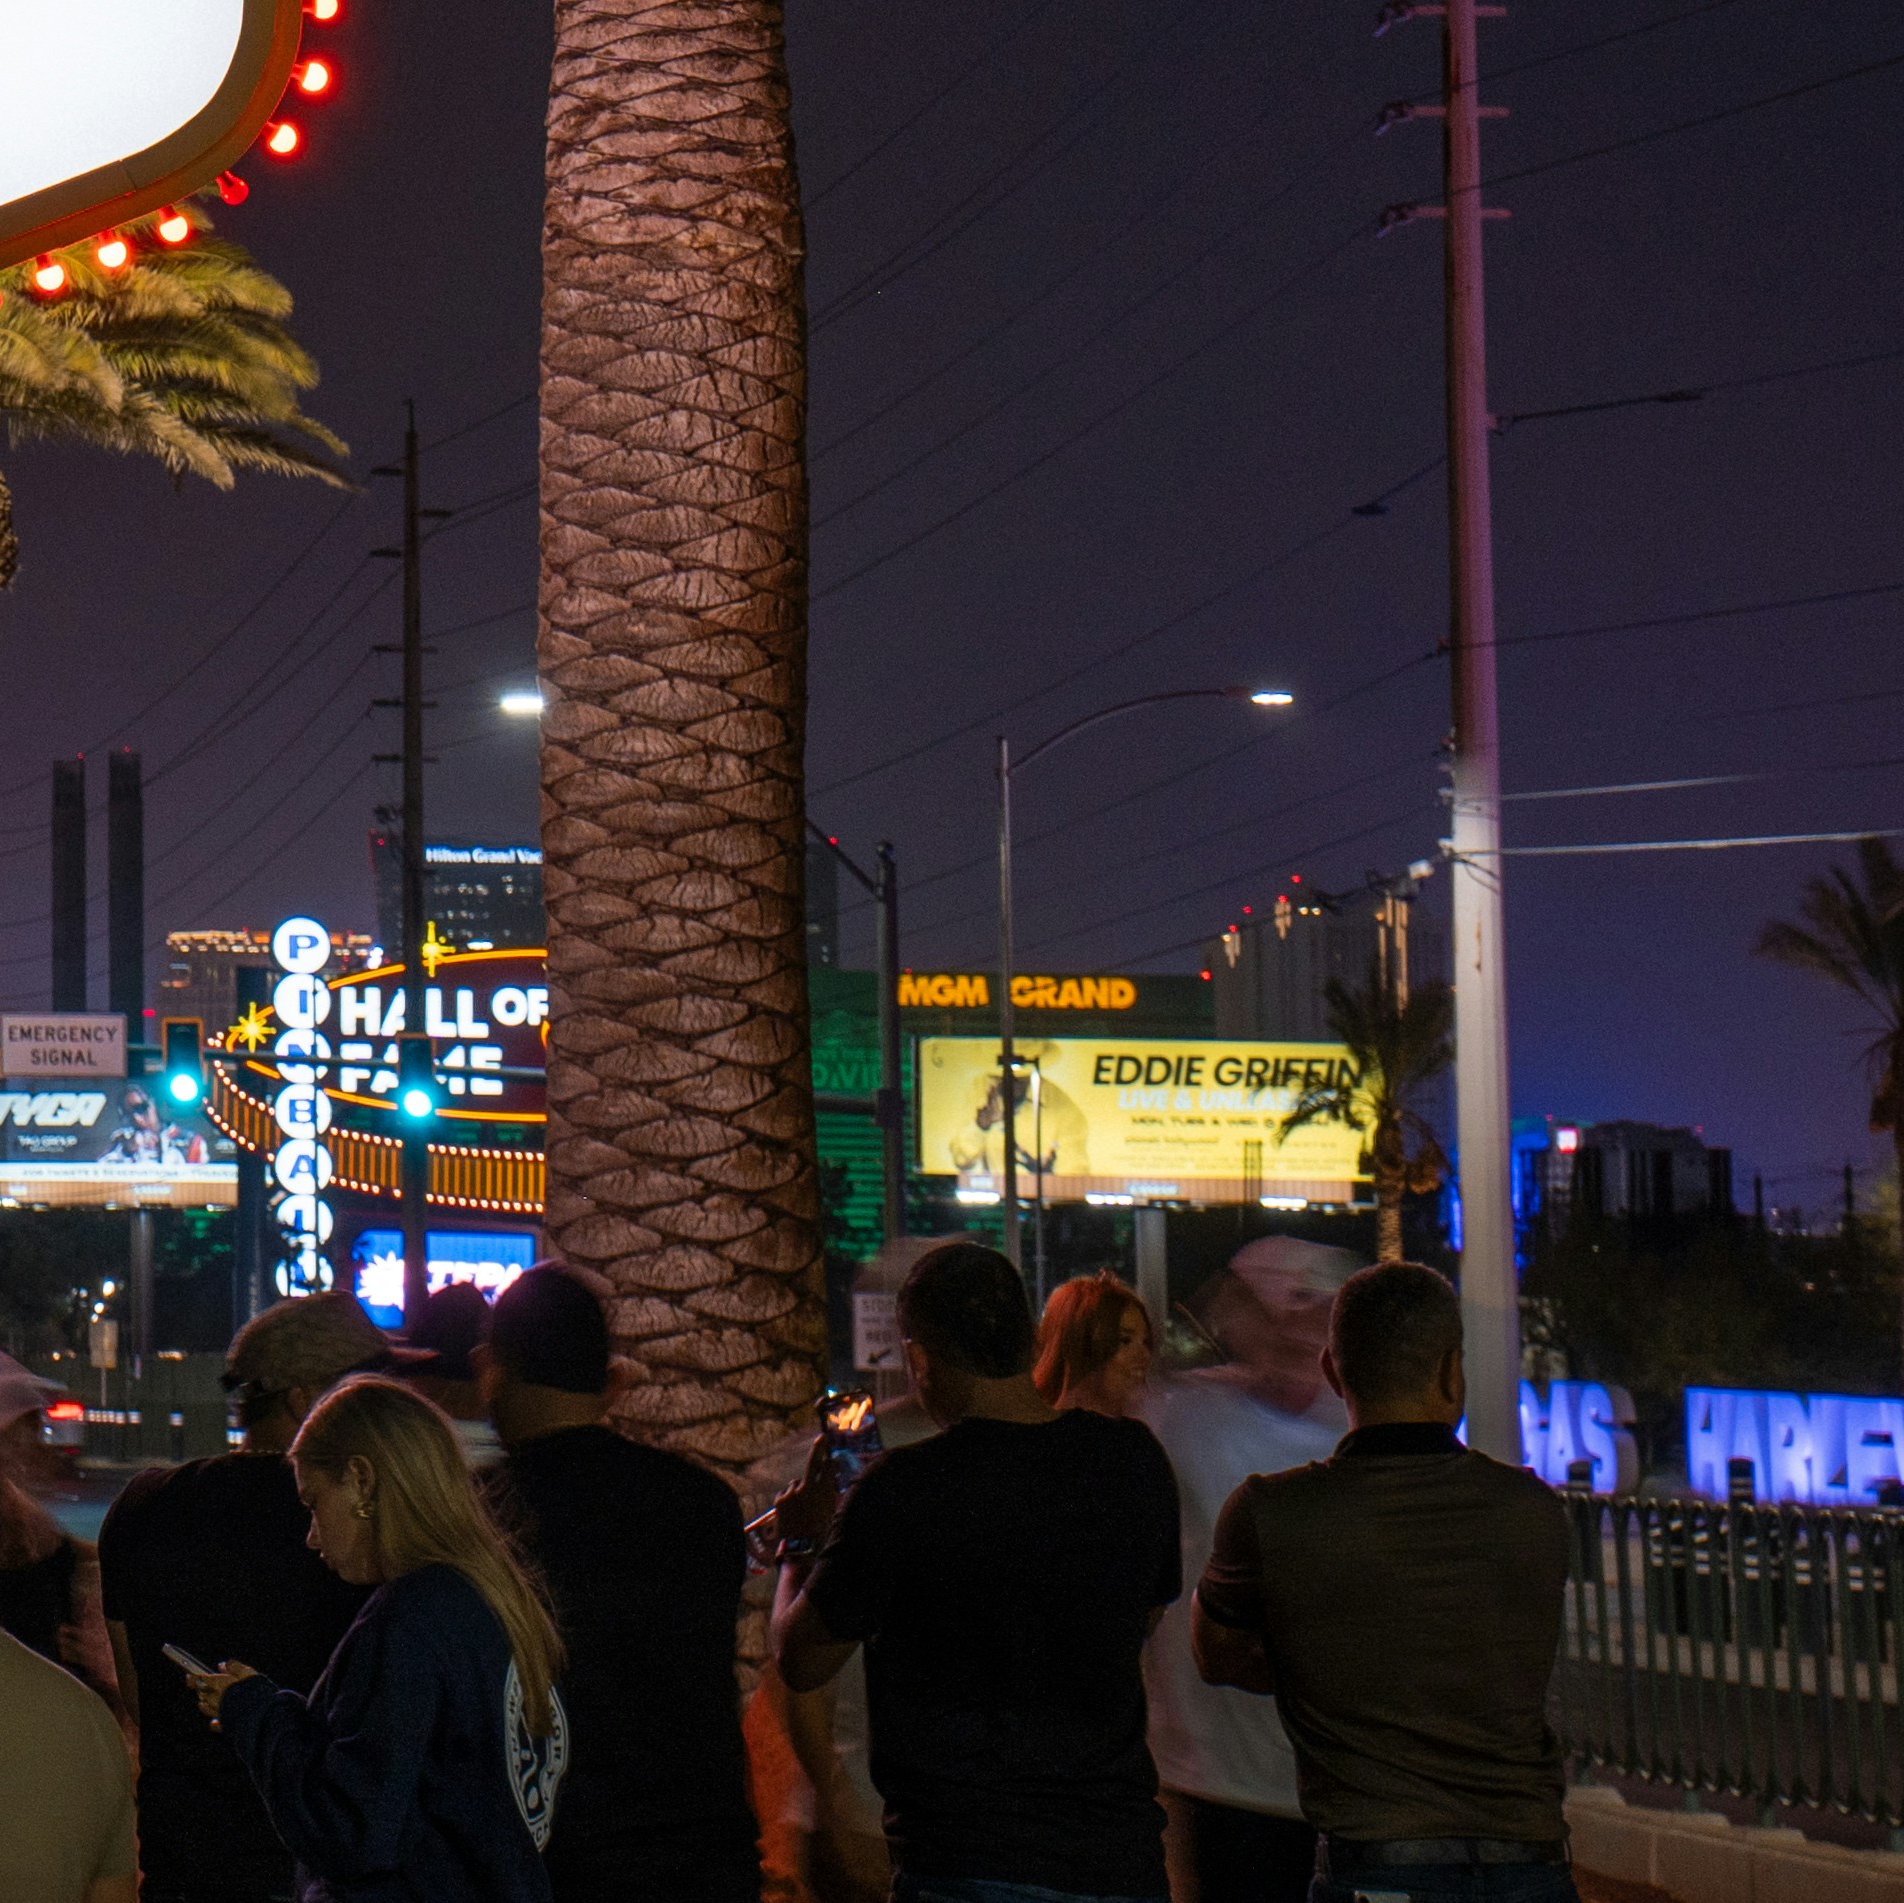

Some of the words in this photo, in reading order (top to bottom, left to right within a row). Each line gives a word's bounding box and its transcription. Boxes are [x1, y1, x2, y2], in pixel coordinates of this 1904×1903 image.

[491, 986, 549, 1027] OF
[898, 975, 990, 1007] MGM
[1009, 976, 1137, 1009] GRAND
[8, 1025, 118, 1043] EMERGENCY
[30, 1048, 97, 1066] SIGNAL
[1093, 1054, 1205, 1086] EDDIE
[1213, 1057, 1364, 1089] GRIFFIN
